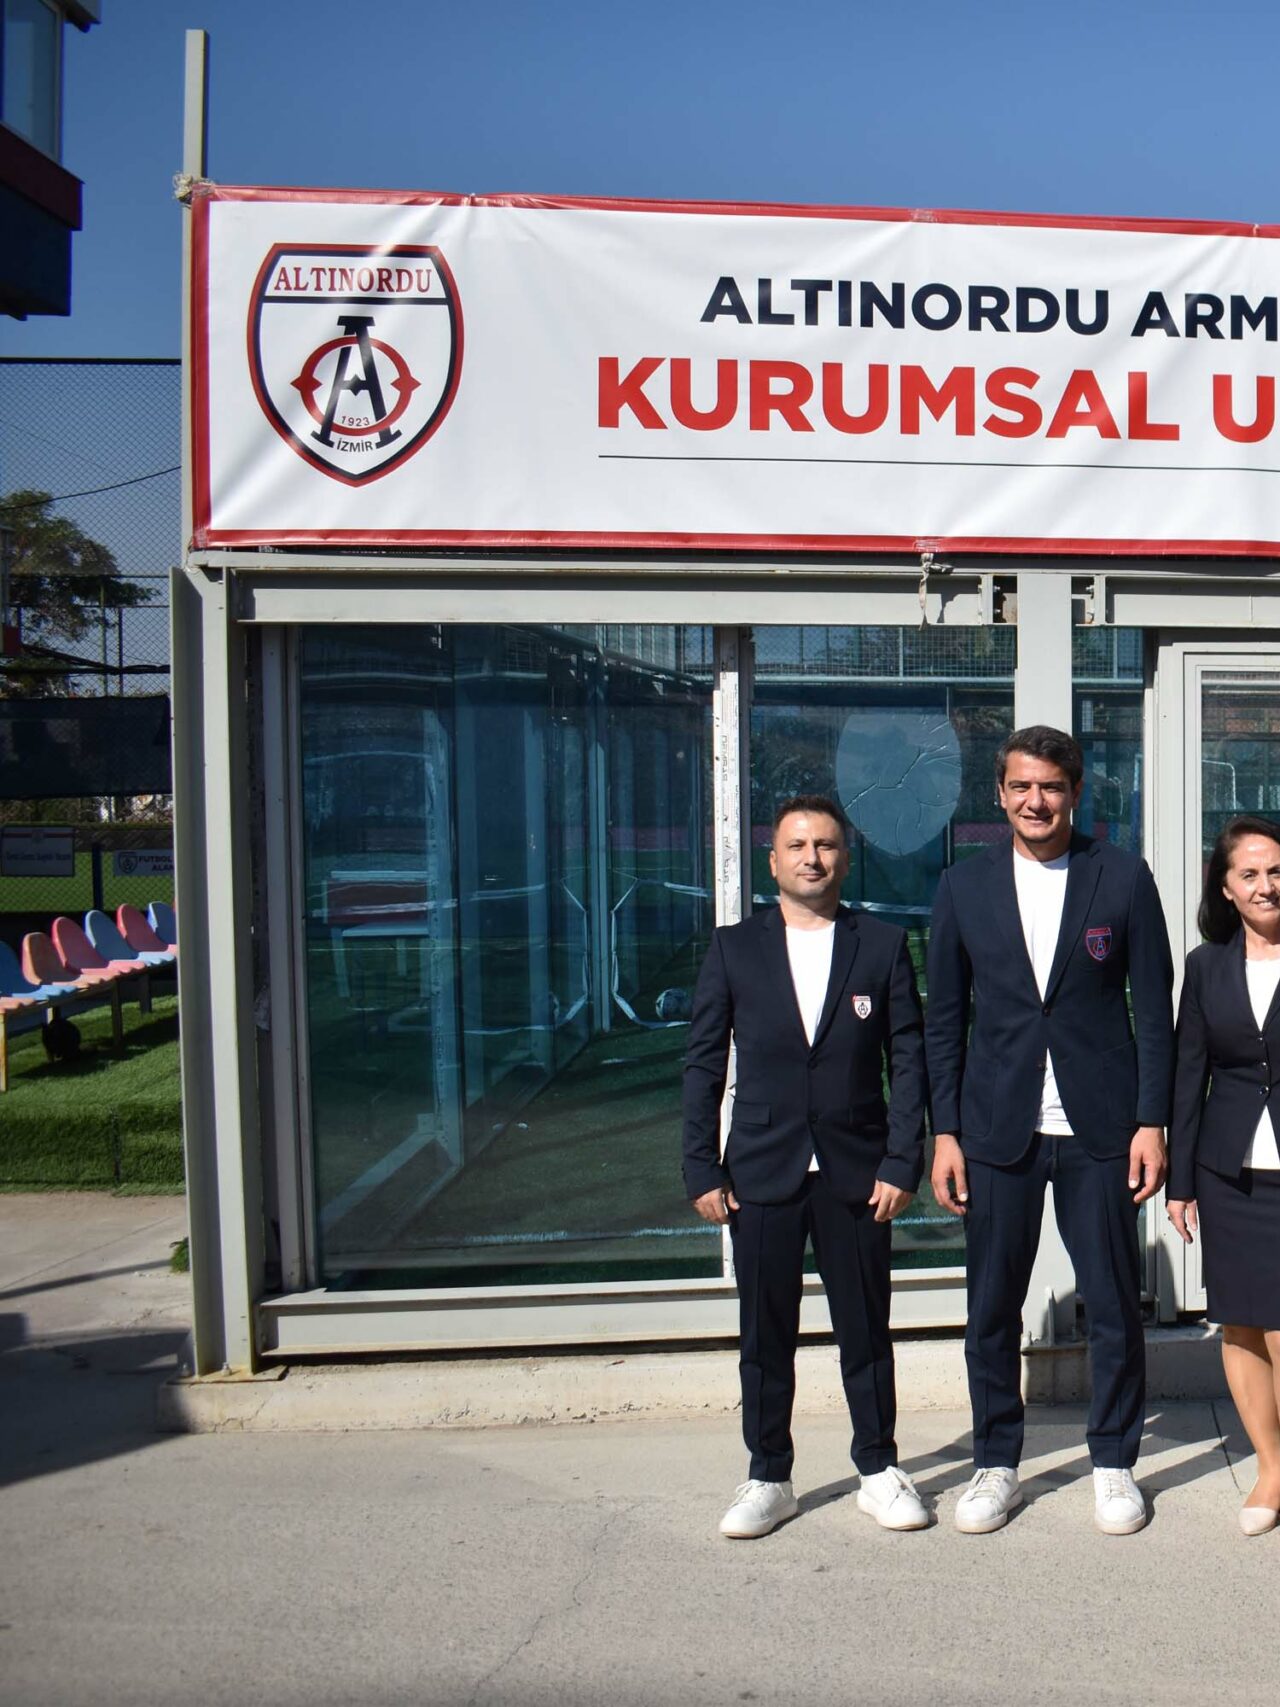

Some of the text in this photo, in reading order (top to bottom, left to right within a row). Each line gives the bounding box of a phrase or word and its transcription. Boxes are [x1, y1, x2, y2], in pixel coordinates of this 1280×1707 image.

[274, 267, 432, 293] ALTINORDU
[701, 277, 1108, 335] ALTINORDU
[599, 357, 1180, 440] KURUMSAL
[341, 416, 370, 427] 1923
[337, 438, 374, 453] İZMİR
[139, 855, 173, 863] FUTBOL
